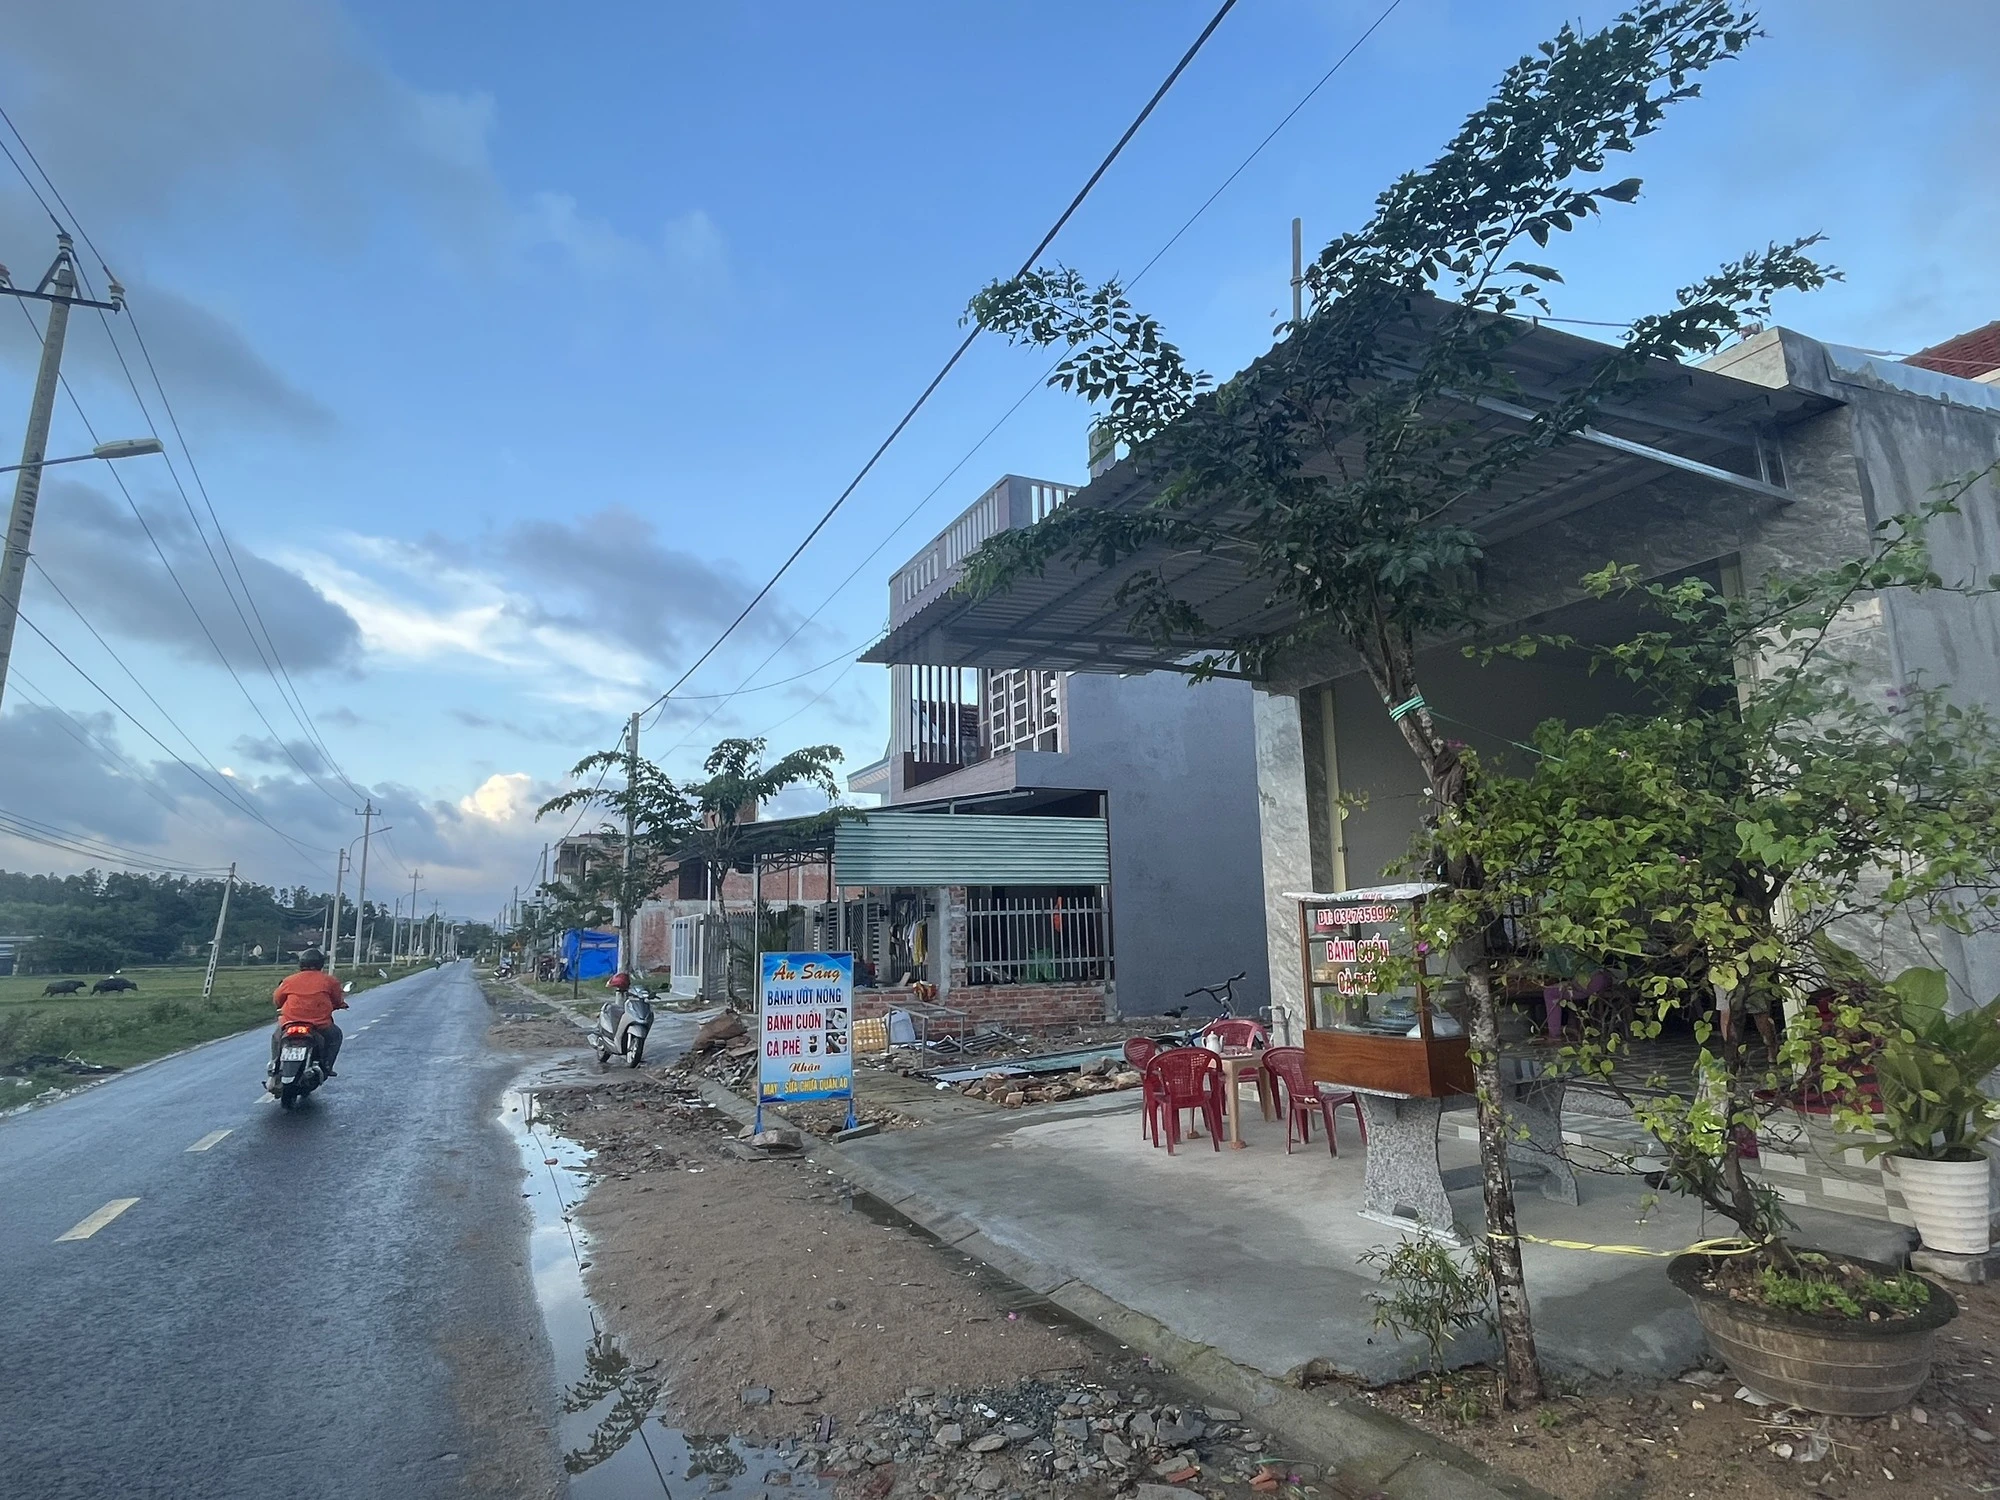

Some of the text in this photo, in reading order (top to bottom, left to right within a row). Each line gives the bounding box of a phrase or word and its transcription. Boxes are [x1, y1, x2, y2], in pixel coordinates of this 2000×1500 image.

[1326, 937, 1357, 962] BÁNH
[772, 960, 841, 983] Ăn Sáng
[767, 987, 793, 1006] BÁNH
[816, 985, 841, 1003] NÓNG
[767, 1008, 821, 1031] BÁNH CUỐN
[766, 1035, 801, 1056] CÀ PHÊ
[789, 1062, 820, 1074] Nhận
[763, 1082, 778, 1095] MAY
